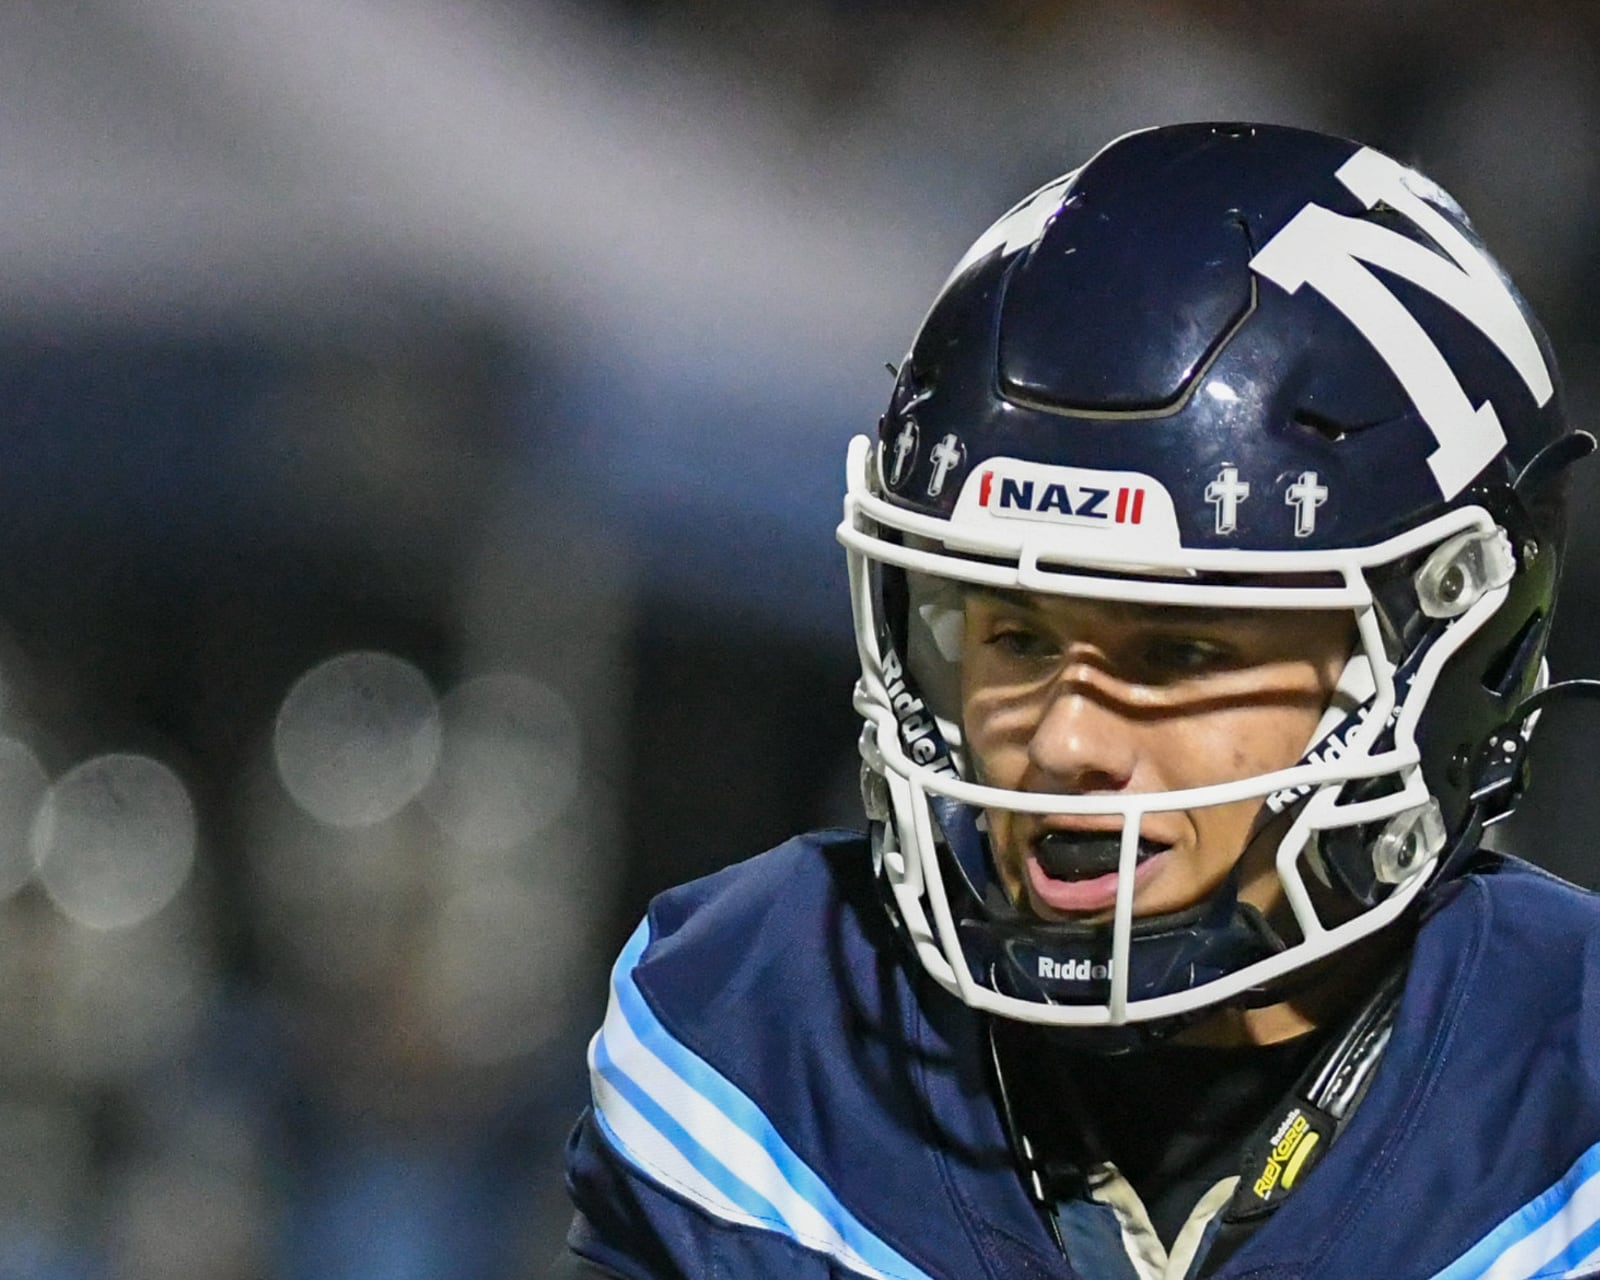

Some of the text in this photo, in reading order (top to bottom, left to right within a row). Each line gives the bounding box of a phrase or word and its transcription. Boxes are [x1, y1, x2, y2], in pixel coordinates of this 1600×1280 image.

[1249, 146, 1554, 502] N
[1000, 478, 1110, 519] NAZ
[1038, 956, 1114, 980] Riddel
